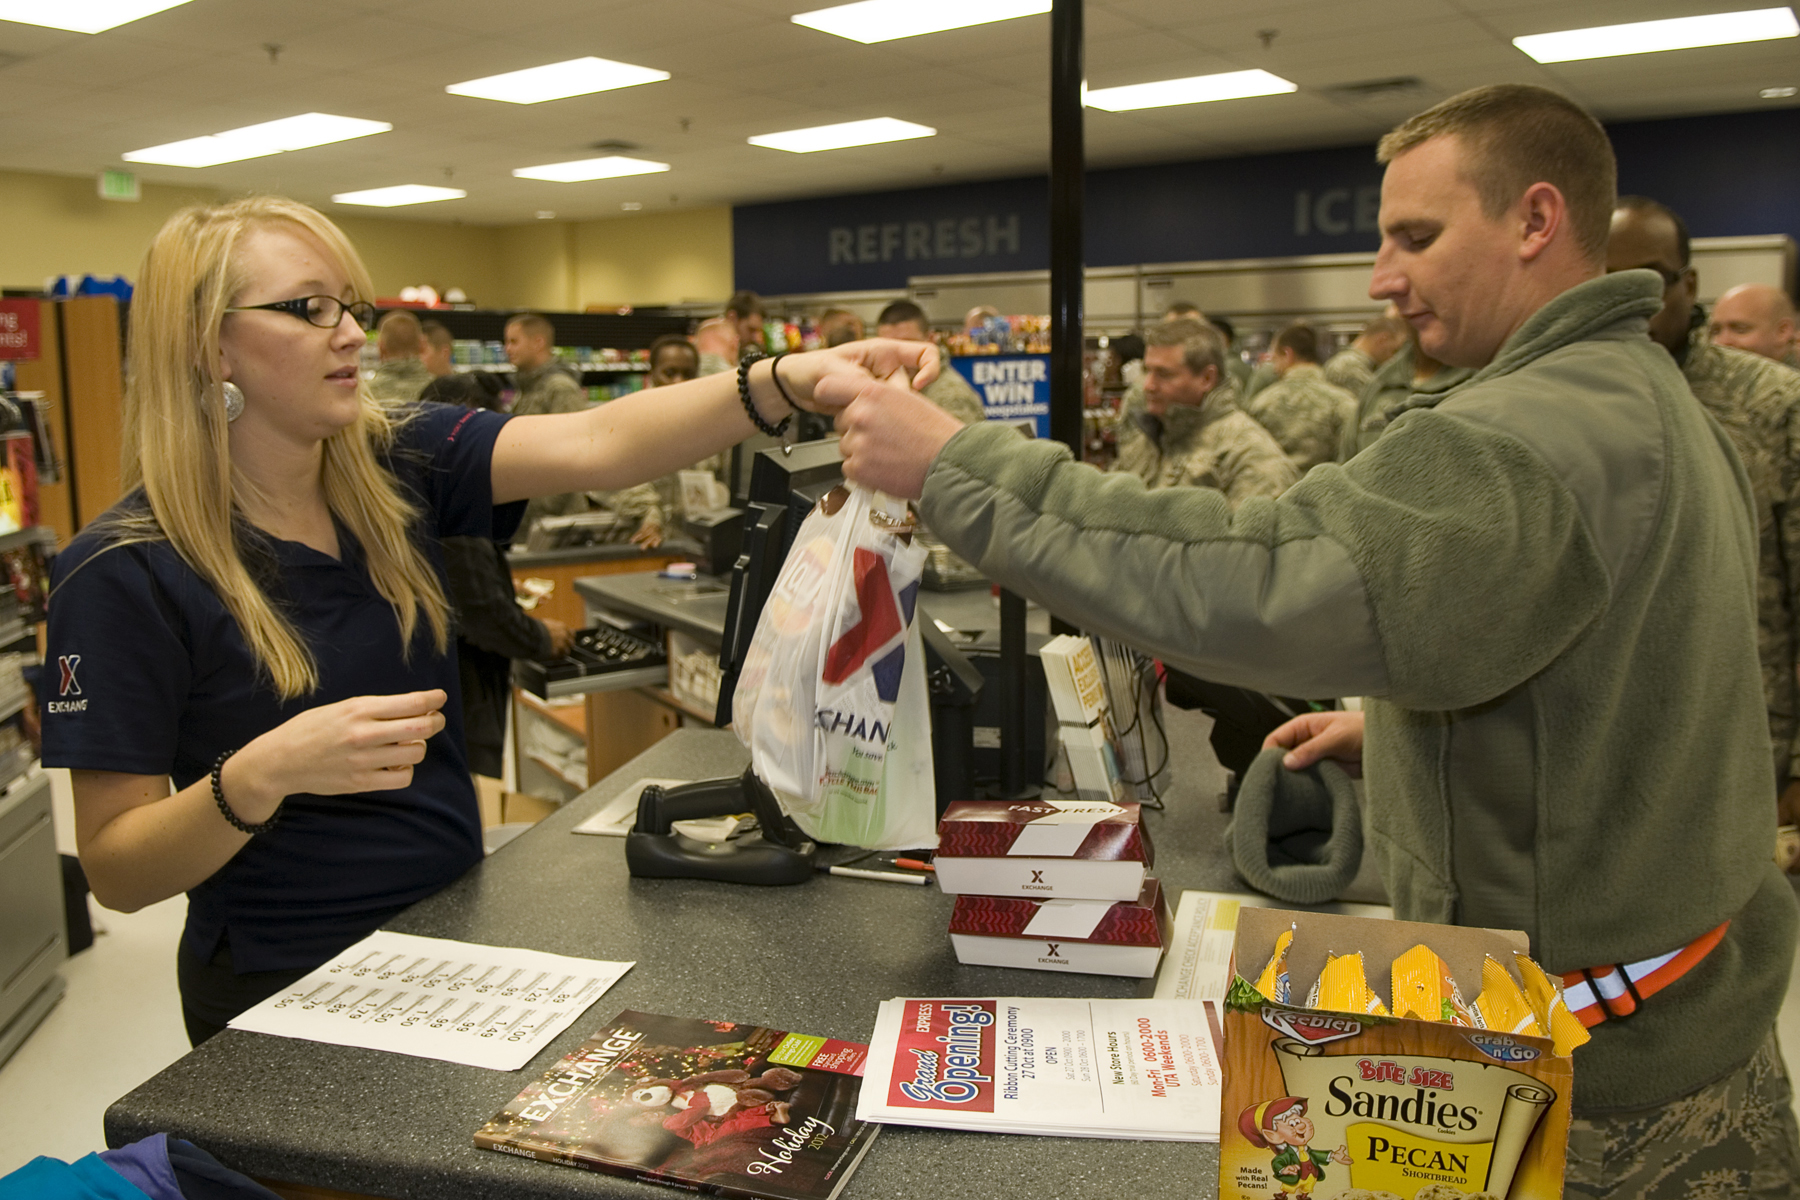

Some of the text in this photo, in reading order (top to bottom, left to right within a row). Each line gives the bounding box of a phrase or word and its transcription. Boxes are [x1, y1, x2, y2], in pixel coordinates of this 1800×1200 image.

[829, 214, 1020, 265] REFRESH
[973, 360, 1047, 384] ENTER
[984, 383, 1034, 405] WIN
[1008, 805, 1056, 814] FAST
[1038, 957, 1070, 965] EXCHANGE
[1174, 968, 1194, 999] XCHANGE
[274, 993, 303, 1009] 1.50
[349, 1002, 377, 1020] 1.79
[374, 1006, 403, 1023] 1.50
[400, 1010, 428, 1027] 1.50
[916, 1003, 933, 1033] EXPRESS
[1265, 1006, 1358, 1032] Keebler
[430, 1015, 449, 1029] .99
[456, 1019, 475, 1033] .99
[480, 1021, 507, 1038] 1.49
[507, 1024, 534, 1042] 1.00
[1062, 1030, 1072, 1043] 2000
[1076, 1030, 1086, 1042] 1700
[1469, 1034, 1516, 1047] Grab
[811, 1052, 830, 1068] FREE
[829, 1047, 853, 1070] shipping
[931, 1003, 995, 1104] Opening!
[1004, 1006, 1021, 1099] Ribbon Cutting Ceremony
[1021, 1028, 1035, 1079] 27 Oct at 0900
[1045, 1046, 1058, 1065] OPEN
[1107, 1031, 1125, 1085] New Store Hours
[1137, 1017, 1167, 1098] Mon-Fri 0600-2000
[1154, 1030, 1181, 1088] UTA Weekends
[1179, 1034, 1203, 1087] Saturday 0600-2000
[1195, 1036, 1219, 1086] Sunday 0600-1700
[1510, 1047, 1535, 1060] Go
[1064, 1058, 1074, 1067] Oct
[1079, 1058, 1089, 1067] Oct
[518, 1027, 643, 1122] EXCHANGE
[899, 1048, 940, 1102] Grand
[1357, 1059, 1454, 1091] BITE SIZE
[1325, 1075, 1478, 1131] Sandies
[1437, 1127, 1456, 1136] Cookies
[746, 1116, 835, 1175] Holiday
[808, 1132, 830, 1150] 2012
[493, 1143, 537, 1159] EXCHANGE
[1366, 1135, 1470, 1174] PECAN
[552, 1157, 590, 1170] HOLIDAY 2012
[1240, 1167, 1262, 1175] Made
[1402, 1167, 1467, 1185] SHORTBREAD
